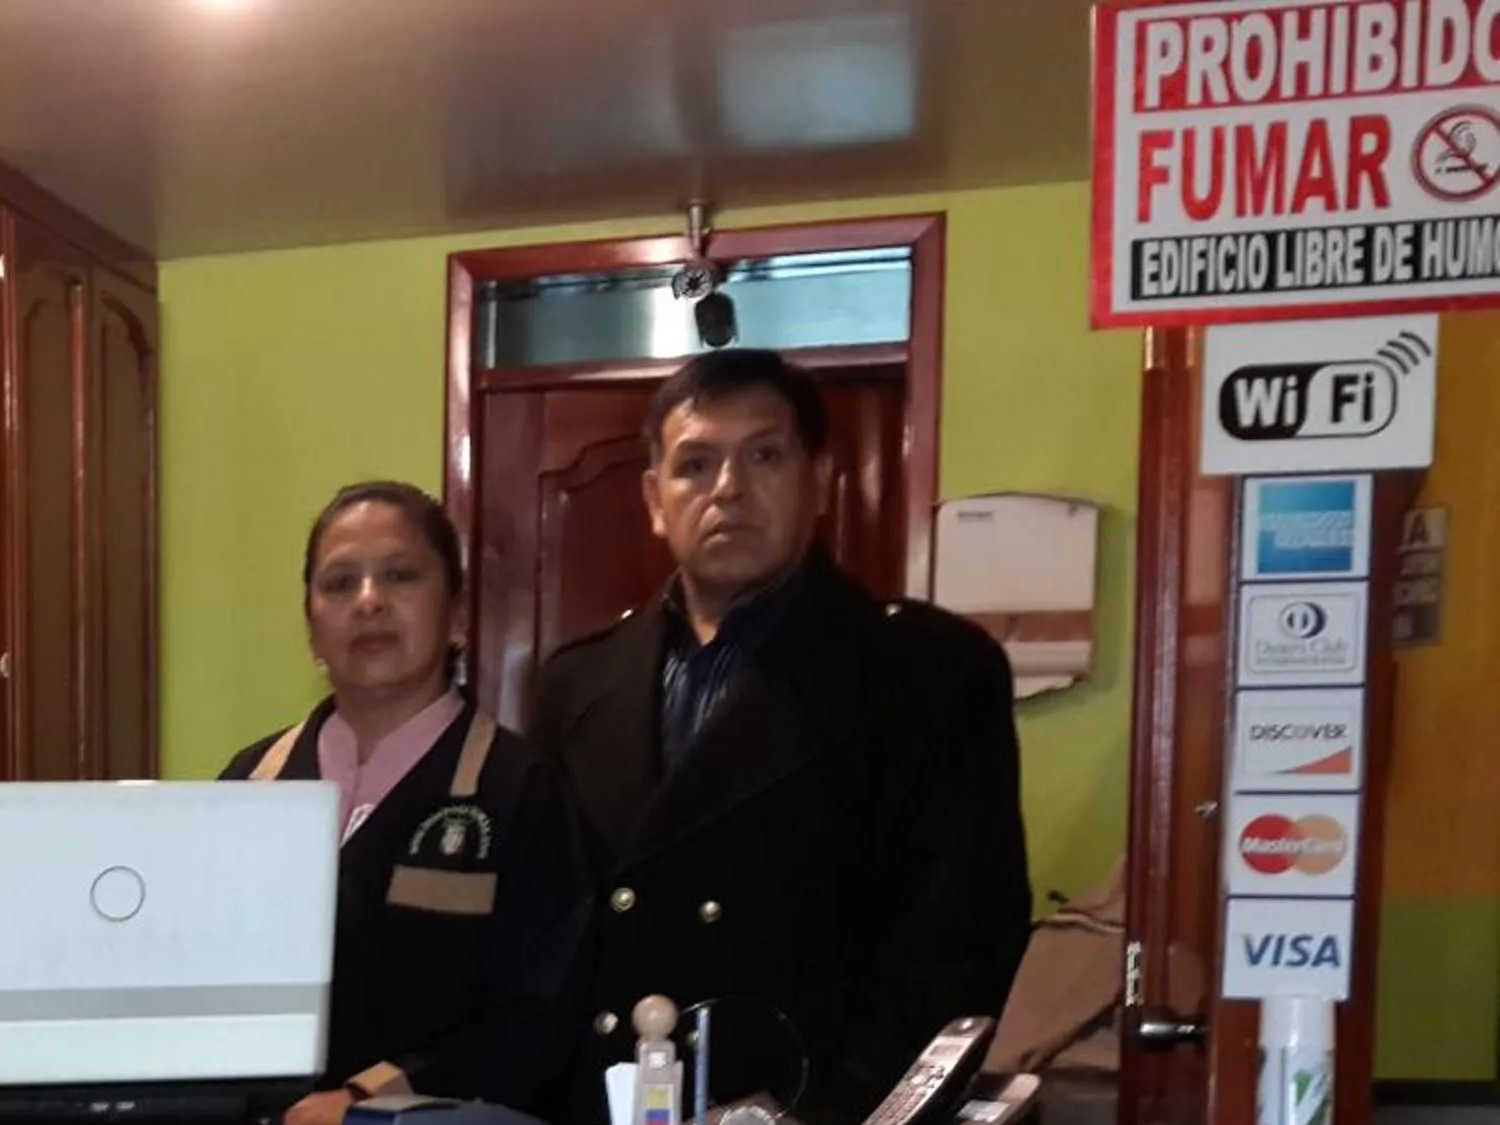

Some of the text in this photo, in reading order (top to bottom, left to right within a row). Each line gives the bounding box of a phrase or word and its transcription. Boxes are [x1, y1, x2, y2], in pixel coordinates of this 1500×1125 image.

[1143, 0, 1500, 110] PROHIBIDO
[1137, 114, 1392, 224] FUMAR
[1140, 216, 1500, 297] EDIFICIO LIBRE DE HUM
[1249, 723, 1348, 741] DISCOVER
[1241, 933, 1341, 968] VISA
